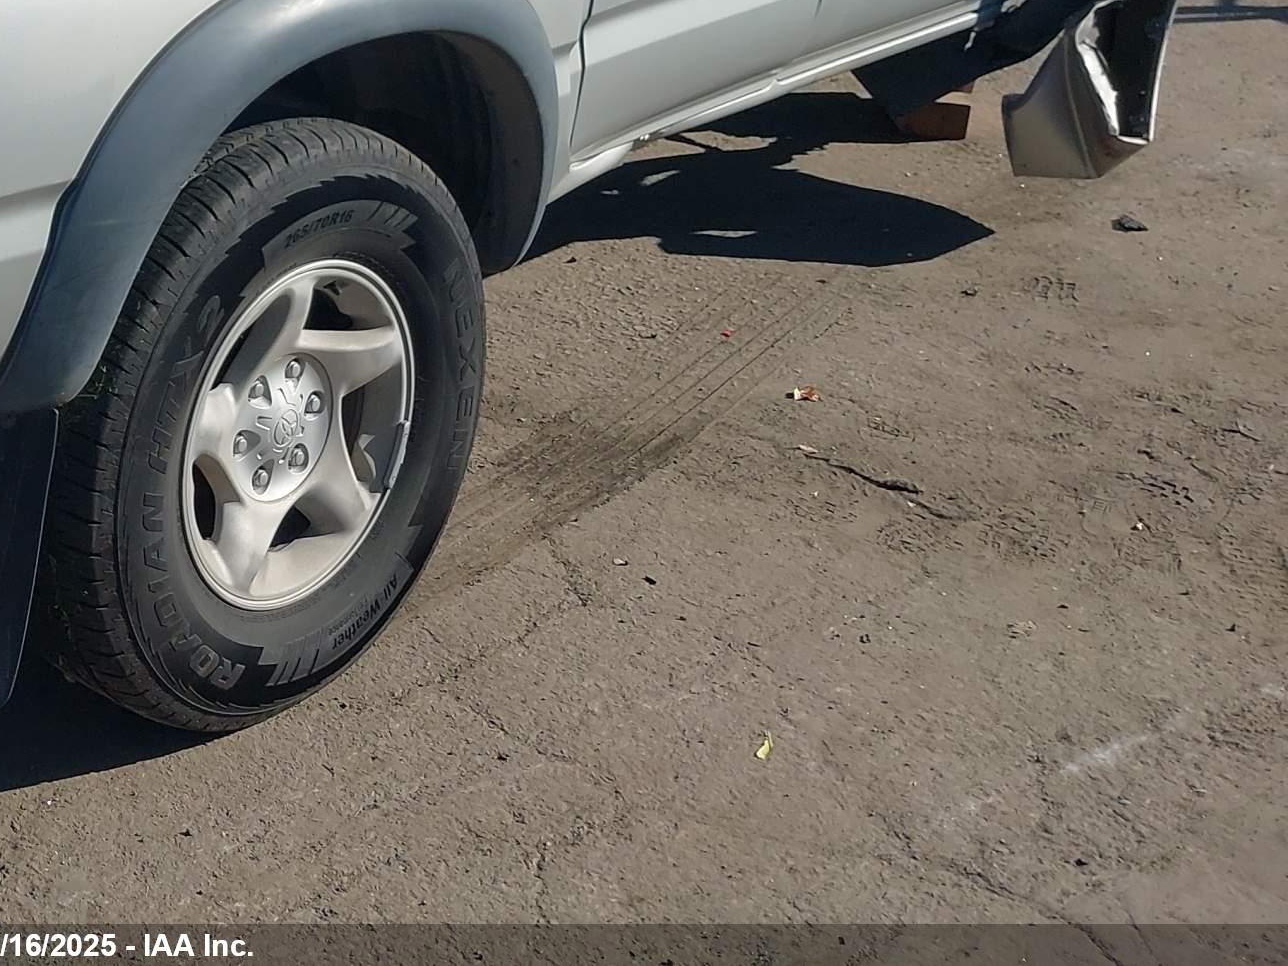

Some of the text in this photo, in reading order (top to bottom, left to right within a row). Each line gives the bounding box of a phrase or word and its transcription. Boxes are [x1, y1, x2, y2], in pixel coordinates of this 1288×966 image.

[443, 258, 476, 470] NEXEN
[142, 491, 246, 690] ROADIAN
[332, 598, 381, 650] Weather
